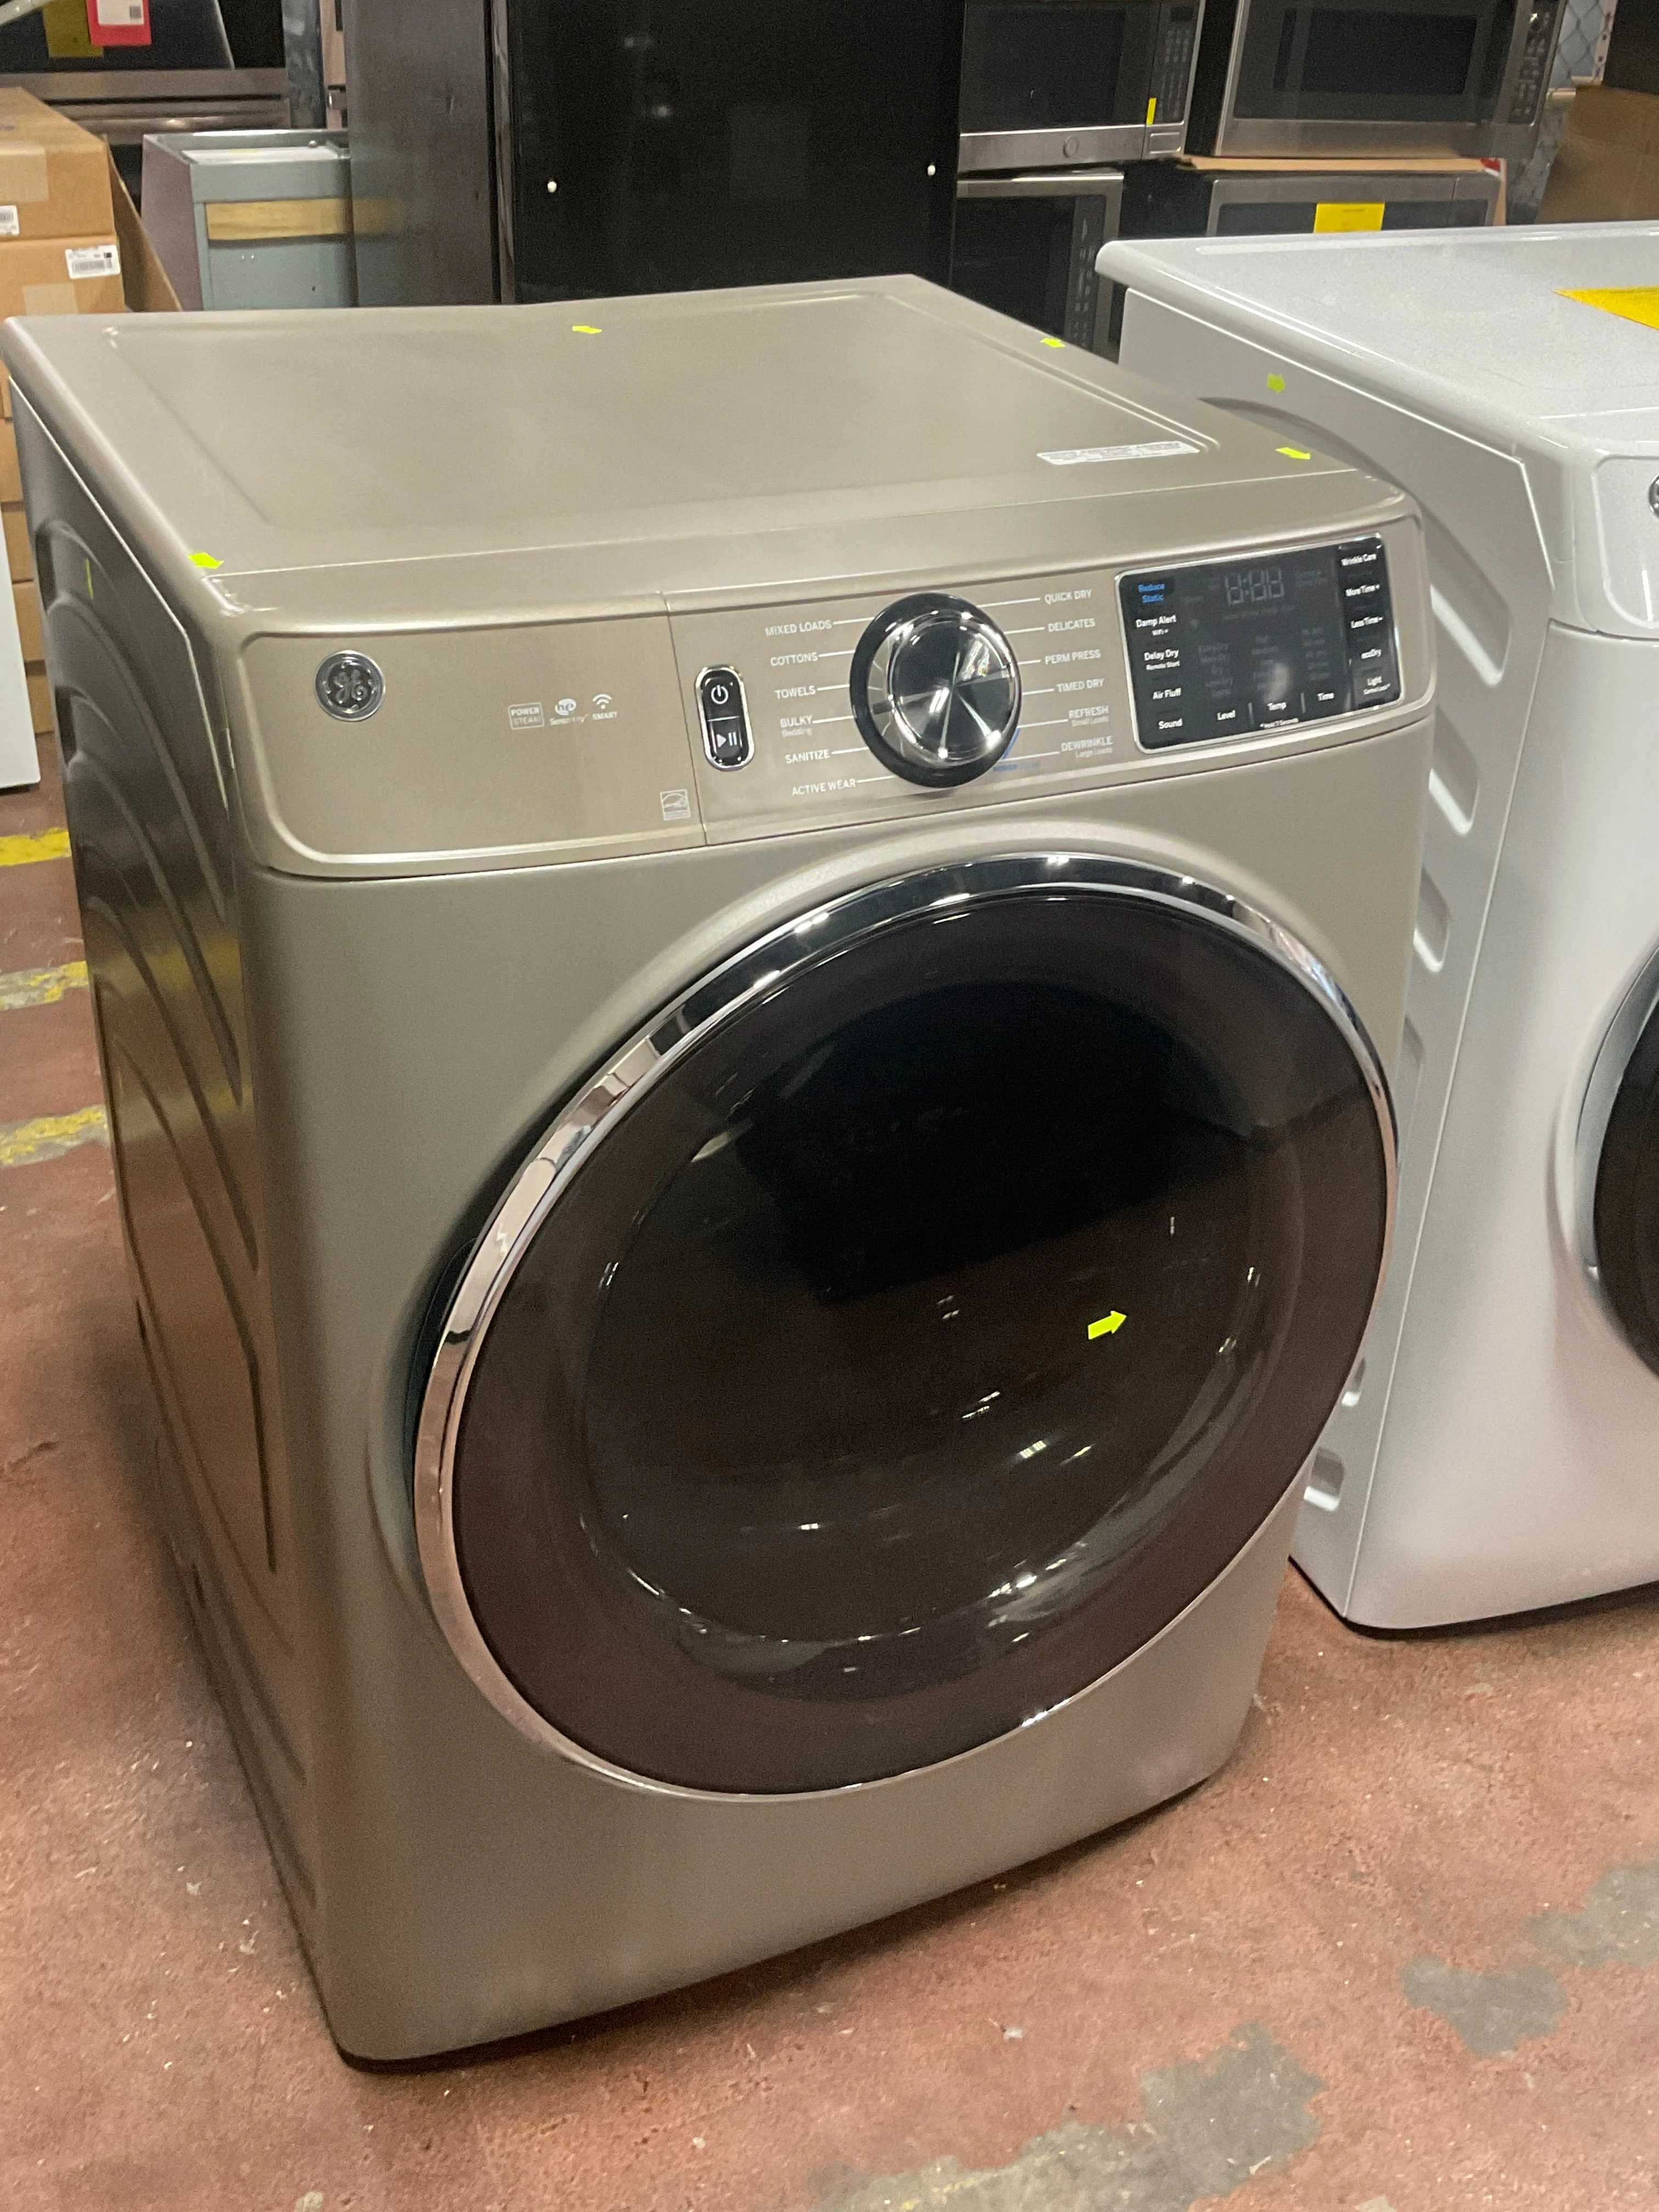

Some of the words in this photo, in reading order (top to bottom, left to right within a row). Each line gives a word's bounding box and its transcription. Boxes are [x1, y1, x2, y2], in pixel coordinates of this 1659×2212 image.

[1044, 591, 1073, 605] QUICK
[1074, 589, 1092, 600] DRY
[765, 624, 797, 636] MIXED
[799, 619, 832, 632] LOADS
[1048, 618, 1096, 633] DELICATES
[1136, 618, 1158, 628] Damp
[1159, 614, 1177, 624] Alert
[770, 652, 818, 666] COTTONS
[1045, 653, 1070, 665] PERM
[1072, 649, 1101, 661] PRESS
[1144, 651, 1164, 661] Delay
[1165, 648, 1180, 658] Dry
[774, 685, 816, 699] TOWELS
[1056, 681, 1085, 692] TIMED
[1086, 678, 1105, 689] DRY
[1153, 691, 1164, 699] Air
[1165, 687, 1182, 698] Fluff
[1317, 692, 1335, 701] Time
[511, 707, 540, 716] POWER
[1069, 706, 1109, 719] REFRESH
[1267, 702, 1286, 711] Temp
[592, 711, 618, 720] SMART
[780, 715, 812, 727] BULKY
[1217, 709, 1235, 720] Level
[1158, 718, 1183, 729] Sound
[1061, 736, 1113, 752] DEWRINKLE
[785, 749, 830, 764] SANITIZE
[792, 783, 826, 796] ACTIVE
[827, 778, 856, 790] WEAR
